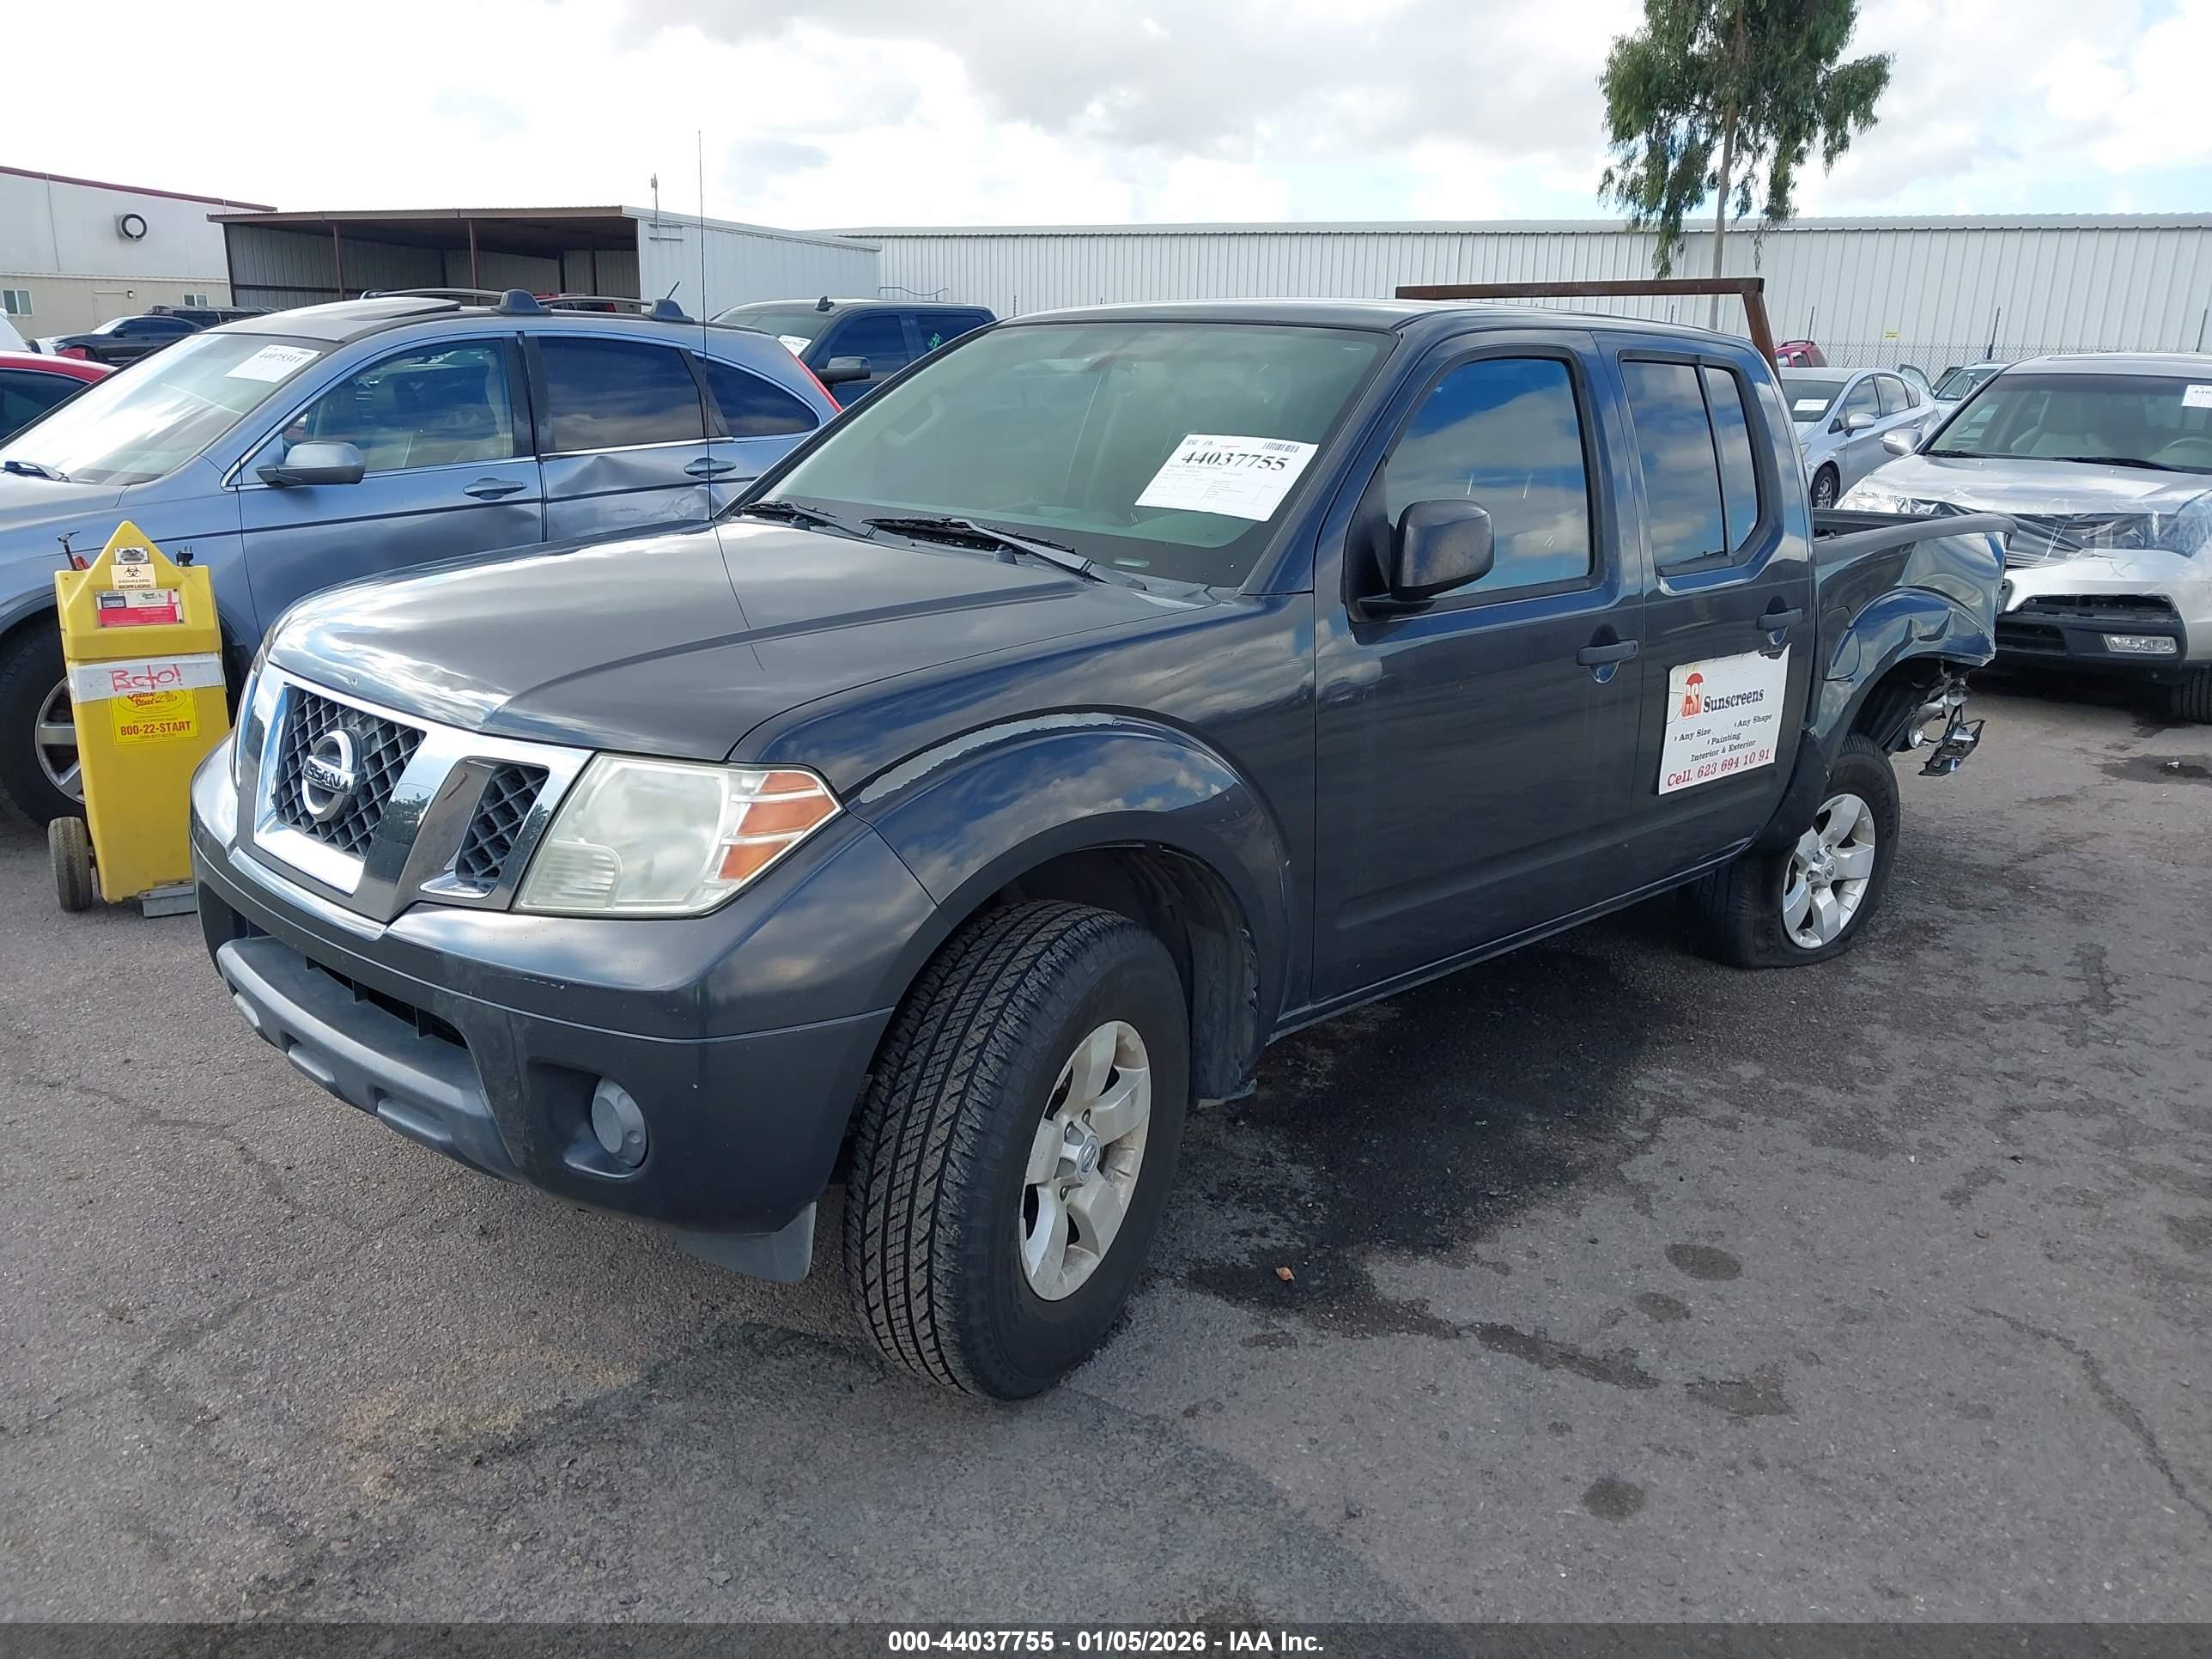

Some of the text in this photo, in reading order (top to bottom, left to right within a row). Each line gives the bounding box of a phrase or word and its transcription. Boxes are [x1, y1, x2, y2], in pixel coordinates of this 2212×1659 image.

[1182, 451, 1290, 471] 44037755
[1704, 689, 1765, 713] Sunscreens
[120, 720, 191, 736] 800-22-START
[1737, 714, 1772, 727] Any Shape
[1679, 728, 1711, 741] Any Size
[1711, 732, 1741, 745] Painting
[1690, 749, 1719, 762] Interior
[1729, 739, 1756, 752] Exterior
[1697, 763, 1717, 778] 623
[1721, 756, 1740, 772] 694
[1743, 752, 1756, 766] 10
[1759, 749, 1770, 761] 91
